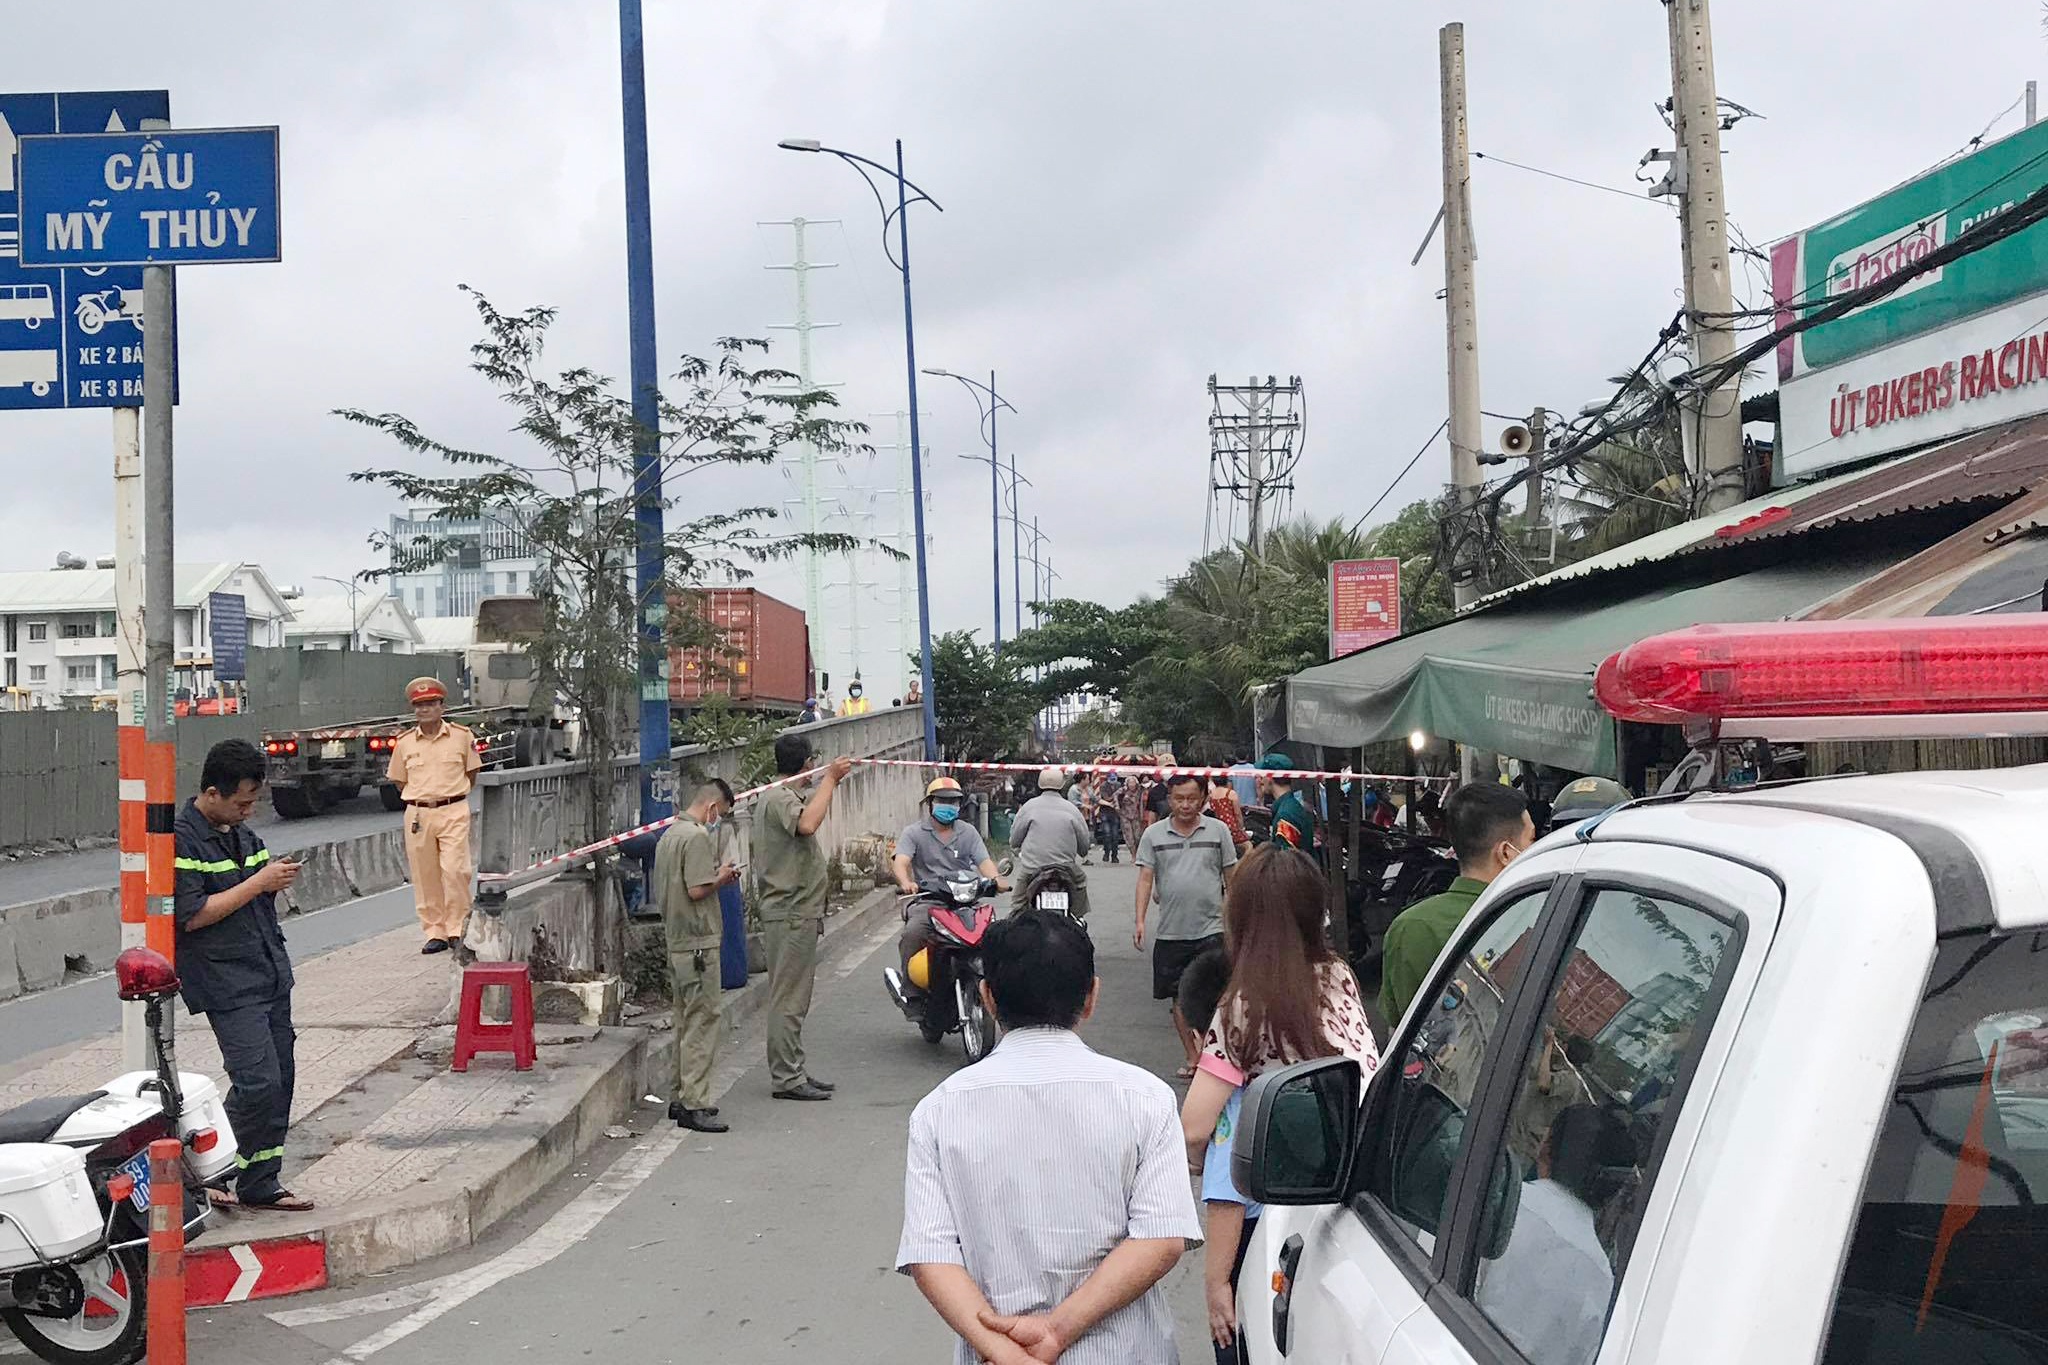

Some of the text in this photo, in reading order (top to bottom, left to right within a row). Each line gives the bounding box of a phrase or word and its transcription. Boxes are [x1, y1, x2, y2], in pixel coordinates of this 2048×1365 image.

[104, 140, 194, 191] CẦU
[46, 191, 257, 250] MỸ THỦY
[79, 341, 144, 365] XE 2 BÁ
[80, 374, 144, 398] XE 3 BÁ
[1830, 331, 2048, 437] ÚT BIKERS RACIN
[1529, 702, 1565, 732] RACING
[1566, 707, 1599, 736] SHOP
